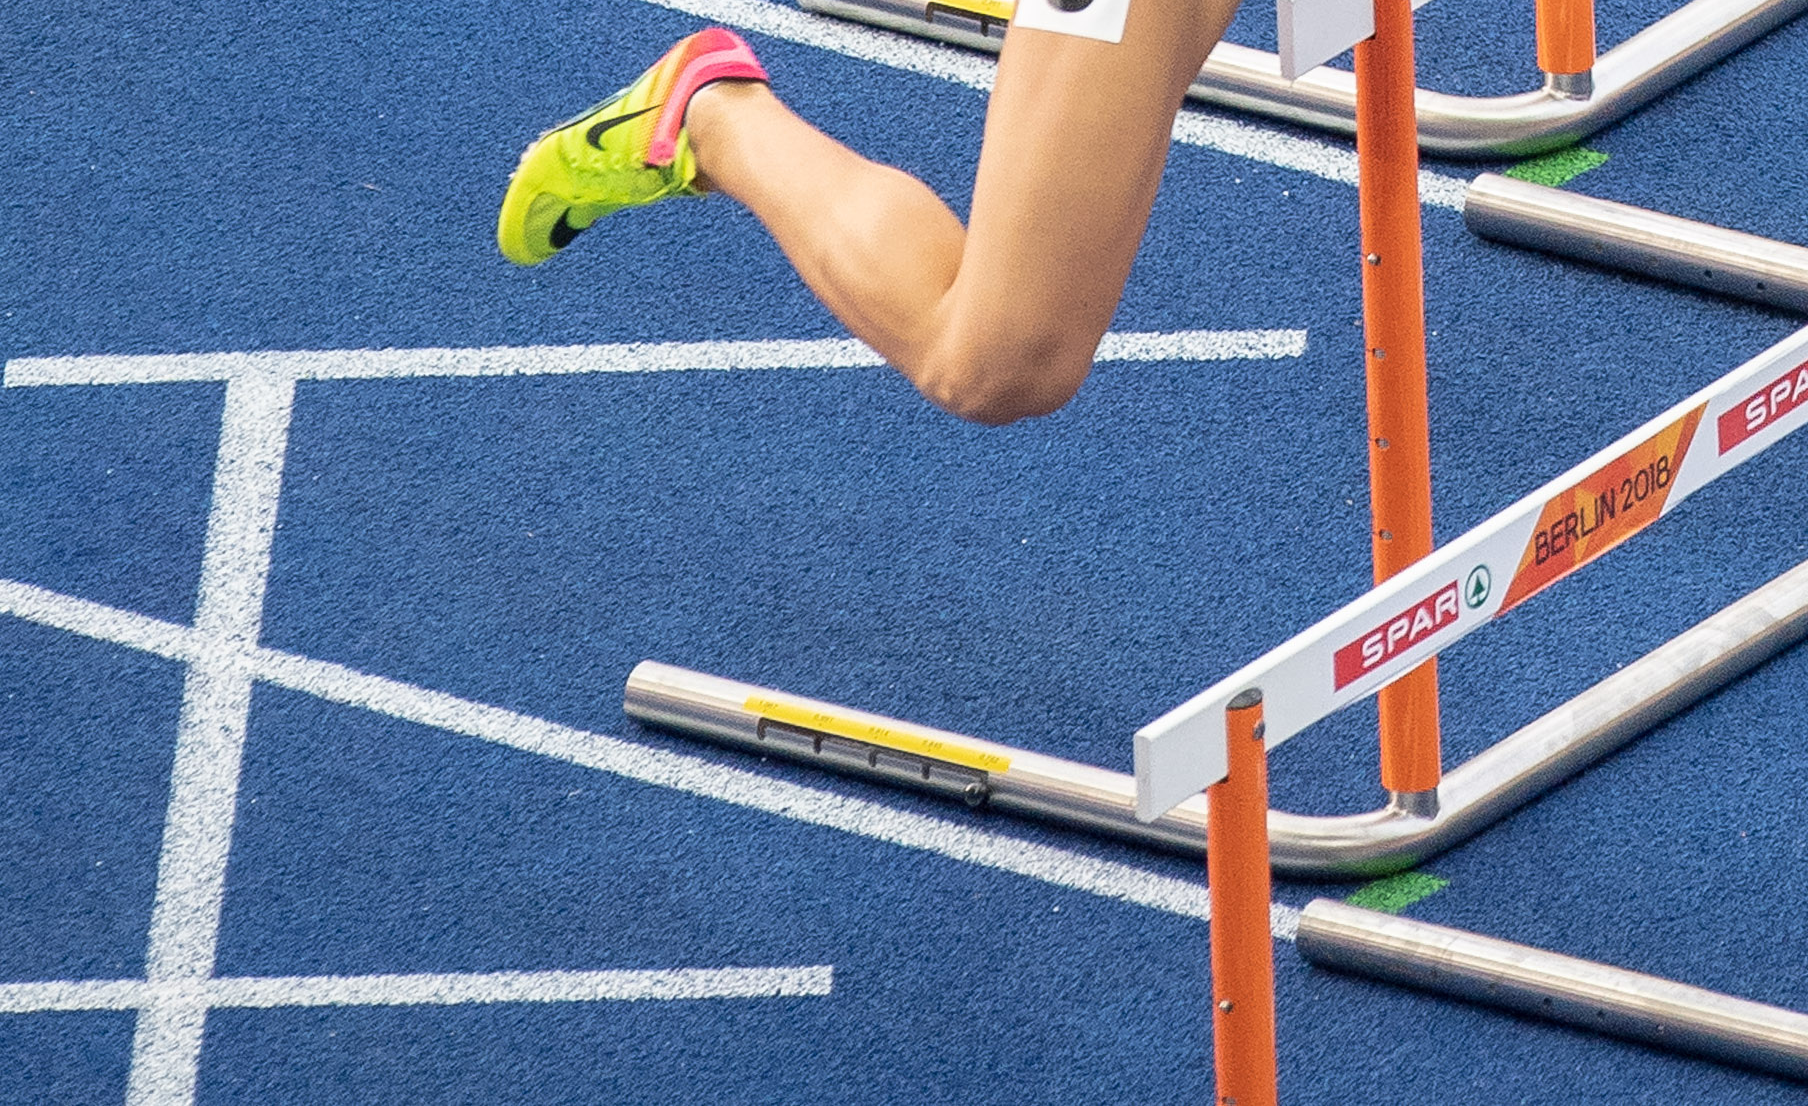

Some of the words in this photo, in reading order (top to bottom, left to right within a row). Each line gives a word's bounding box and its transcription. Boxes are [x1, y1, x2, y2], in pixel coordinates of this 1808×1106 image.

[1534, 488, 1616, 566] BERLIN
[1620, 455, 1671, 512] 2018
[1361, 587, 1457, 669] SPAR
